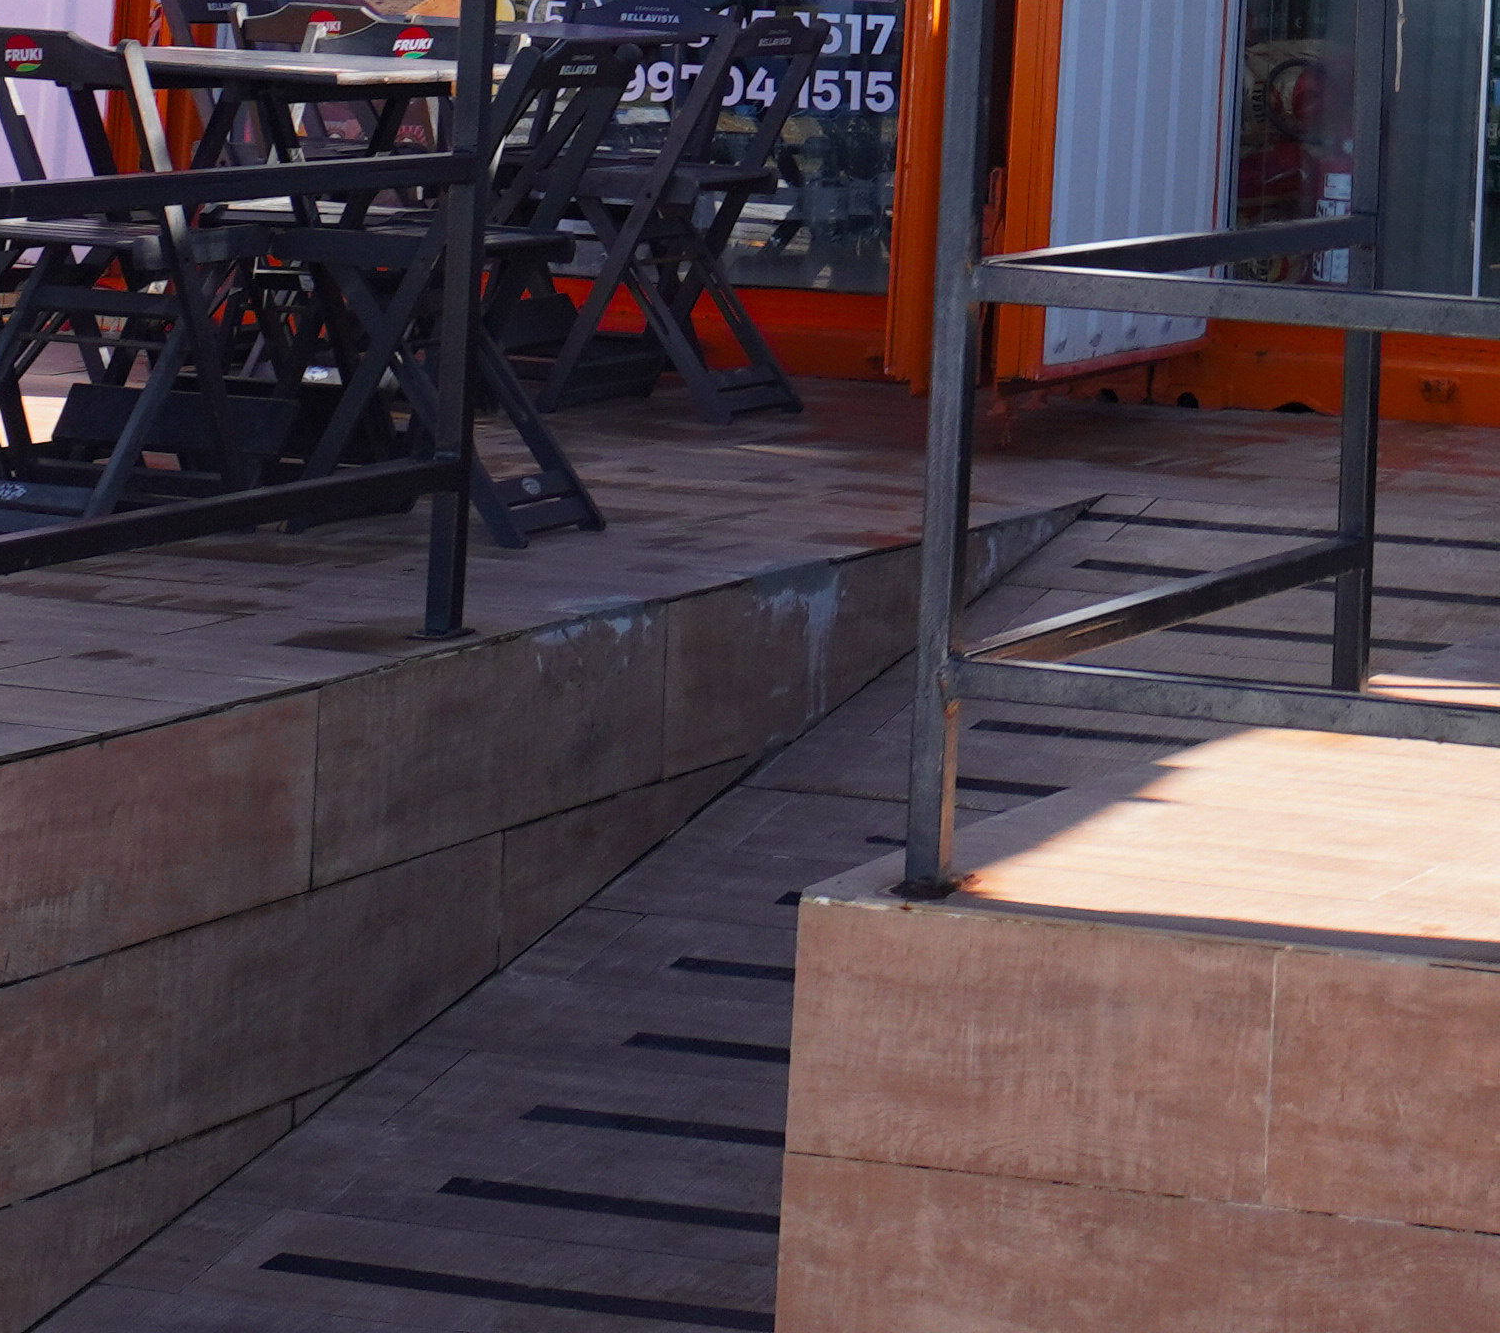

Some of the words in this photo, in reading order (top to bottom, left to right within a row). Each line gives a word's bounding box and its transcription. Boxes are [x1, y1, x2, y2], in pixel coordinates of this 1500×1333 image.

[620, 12, 681, 24] BELLAVISTA
[393, 38, 434, 51] FRUKI
[5, 47, 43, 62] FRUKI
